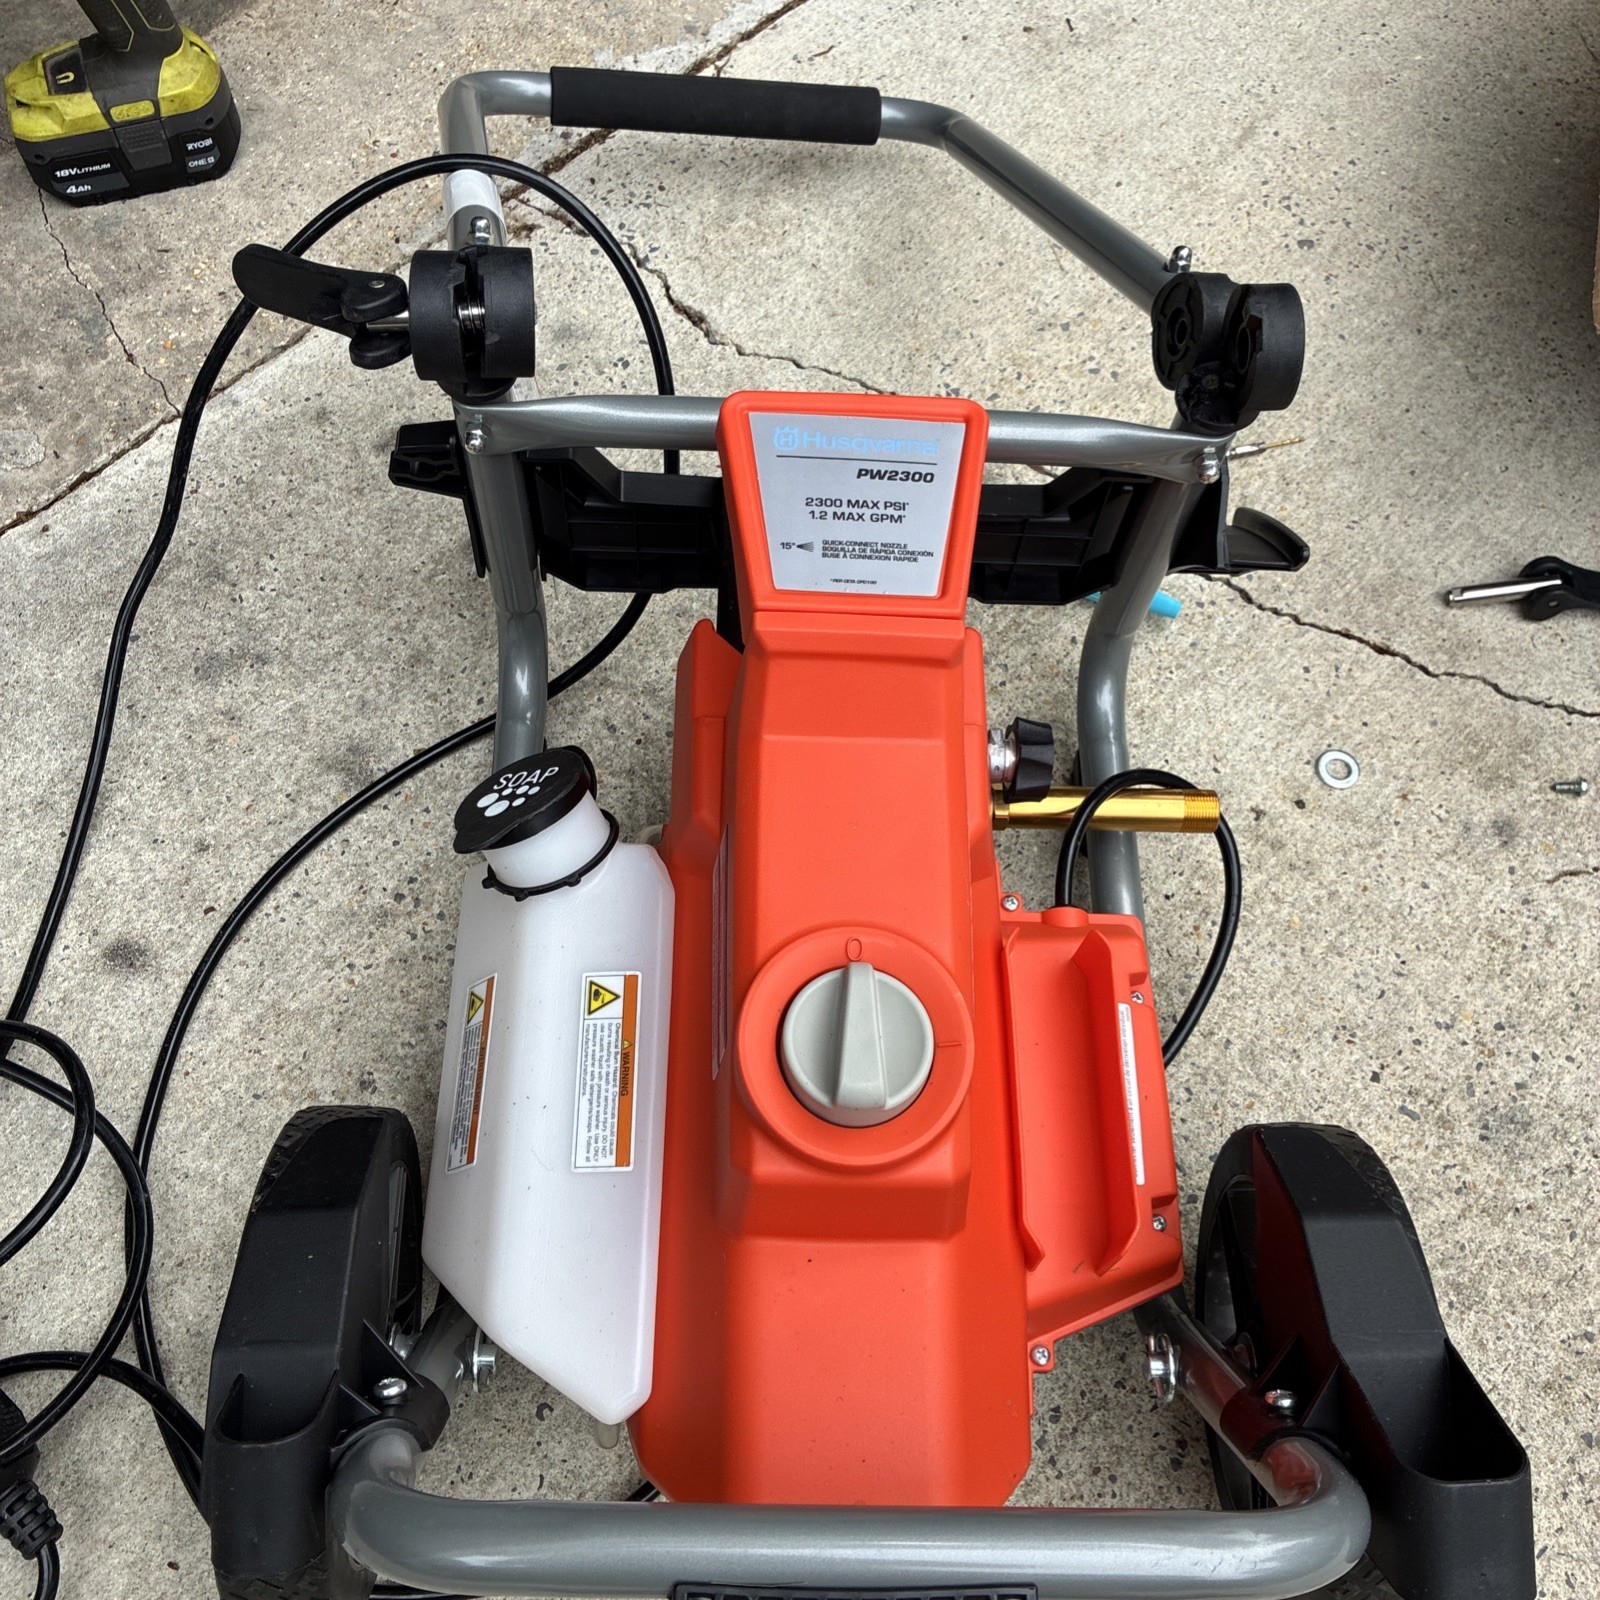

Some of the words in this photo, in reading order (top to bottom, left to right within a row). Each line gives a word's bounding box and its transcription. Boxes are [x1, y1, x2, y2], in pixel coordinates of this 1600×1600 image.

[186, 137, 213, 151] RYOBI
[66, 184, 92, 194] 4Ah
[802, 431, 937, 456] Husqvarna
[856, 468, 935, 483] PW2300
[805, 497, 843, 508] 2300
[847, 499, 880, 510] MAX
[809, 510, 828, 520] 1.2
[832, 511, 865, 522] MAX
[850, 553, 891, 561] CONNEXION
[493, 766, 559, 790] SOAP
[621, 1051, 631, 1096] WARNING
